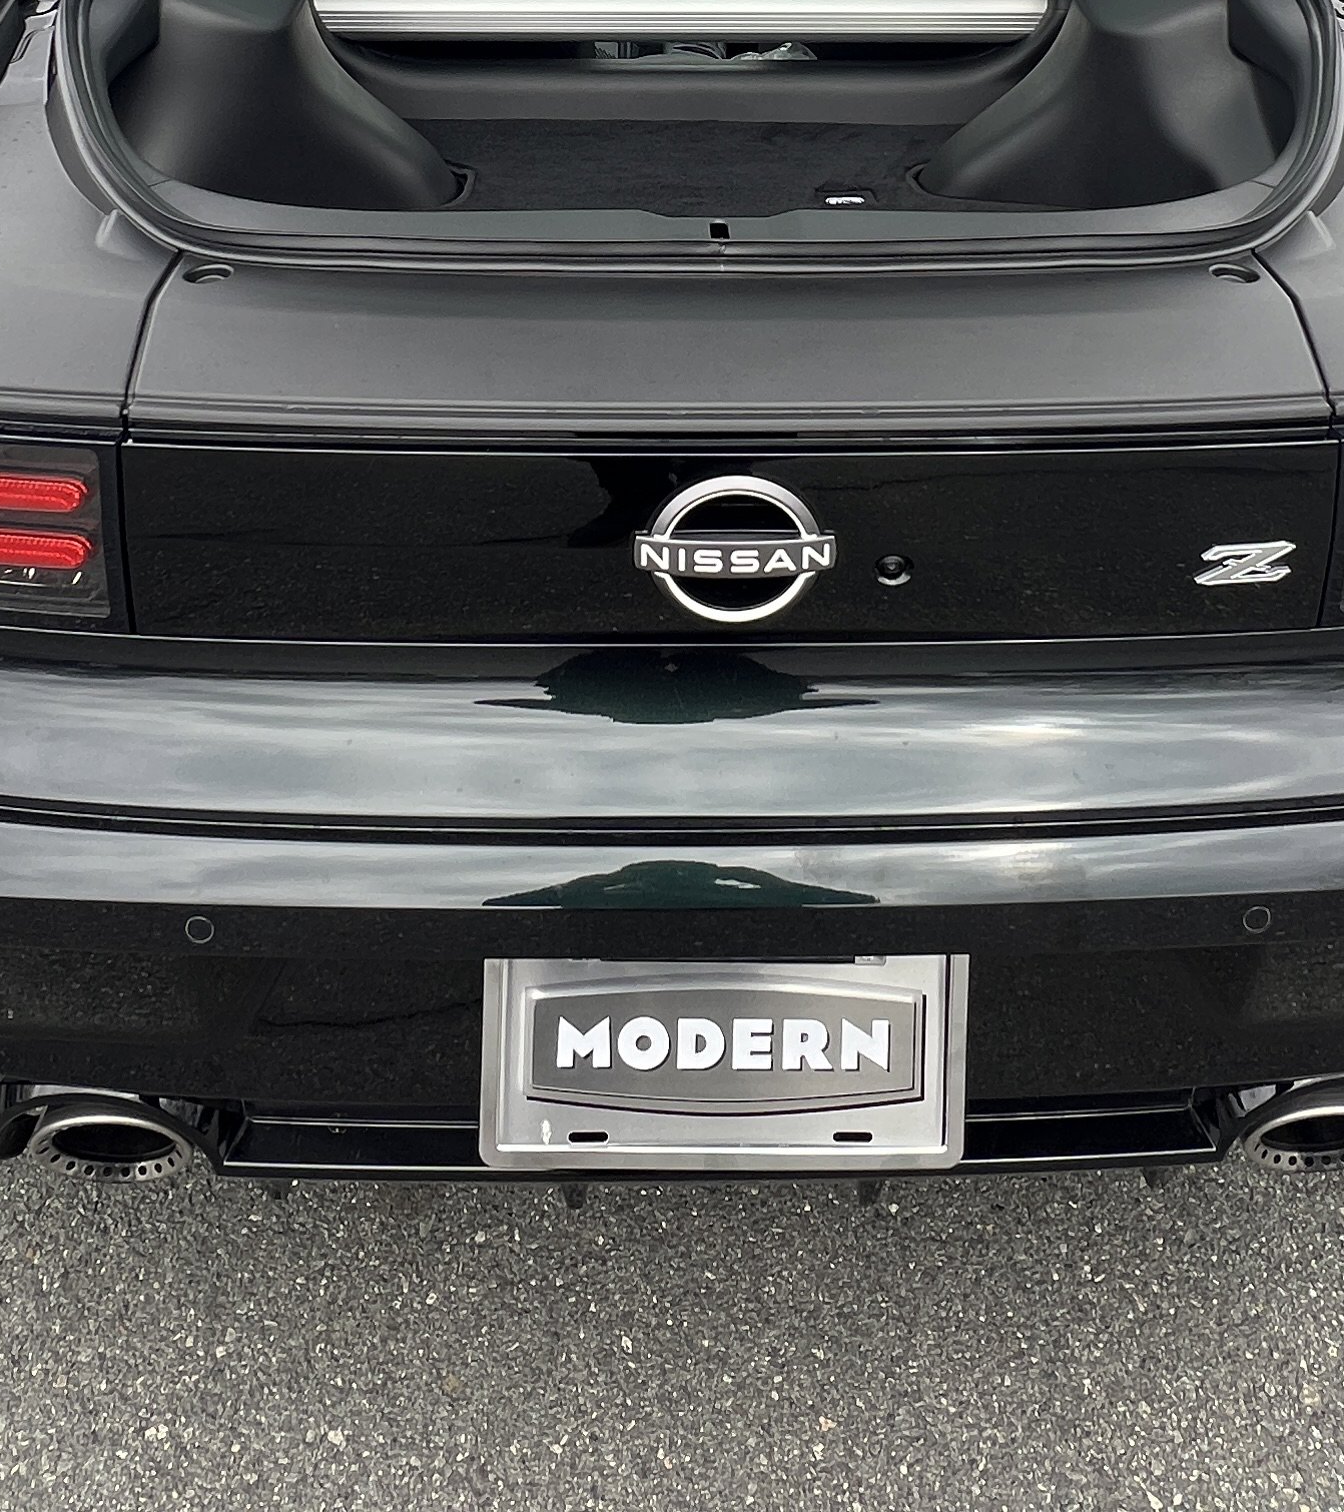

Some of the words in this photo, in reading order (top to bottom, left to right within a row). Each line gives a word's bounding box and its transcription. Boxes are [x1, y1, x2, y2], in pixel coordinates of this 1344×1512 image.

[639, 543, 831, 574] NISSAN
[1194, 540, 1297, 586] Z
[556, 1015, 890, 1071] MODERN
